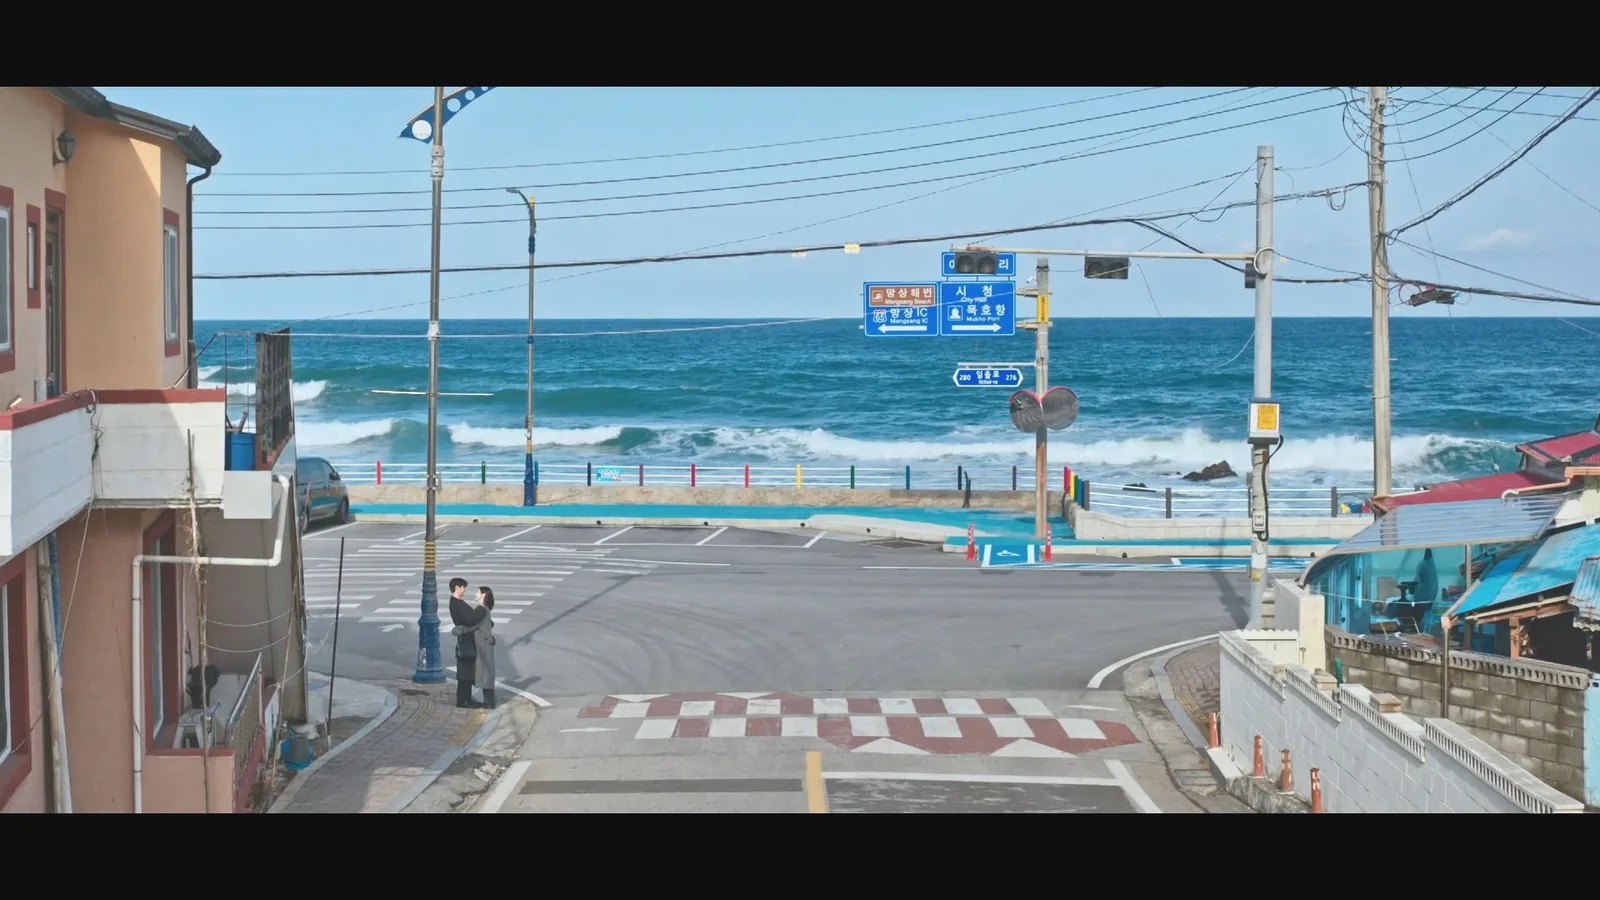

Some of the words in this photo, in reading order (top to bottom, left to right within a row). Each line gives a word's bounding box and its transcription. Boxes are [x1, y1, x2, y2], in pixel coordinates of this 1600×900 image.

[886, 287, 933, 298] 망상해변
[955, 285, 993, 297] 시청
[960, 296, 974, 304] City
[890, 308, 914, 319] 망상
[916, 307, 928, 318] IC
[966, 304, 1006, 316] 묵호항
